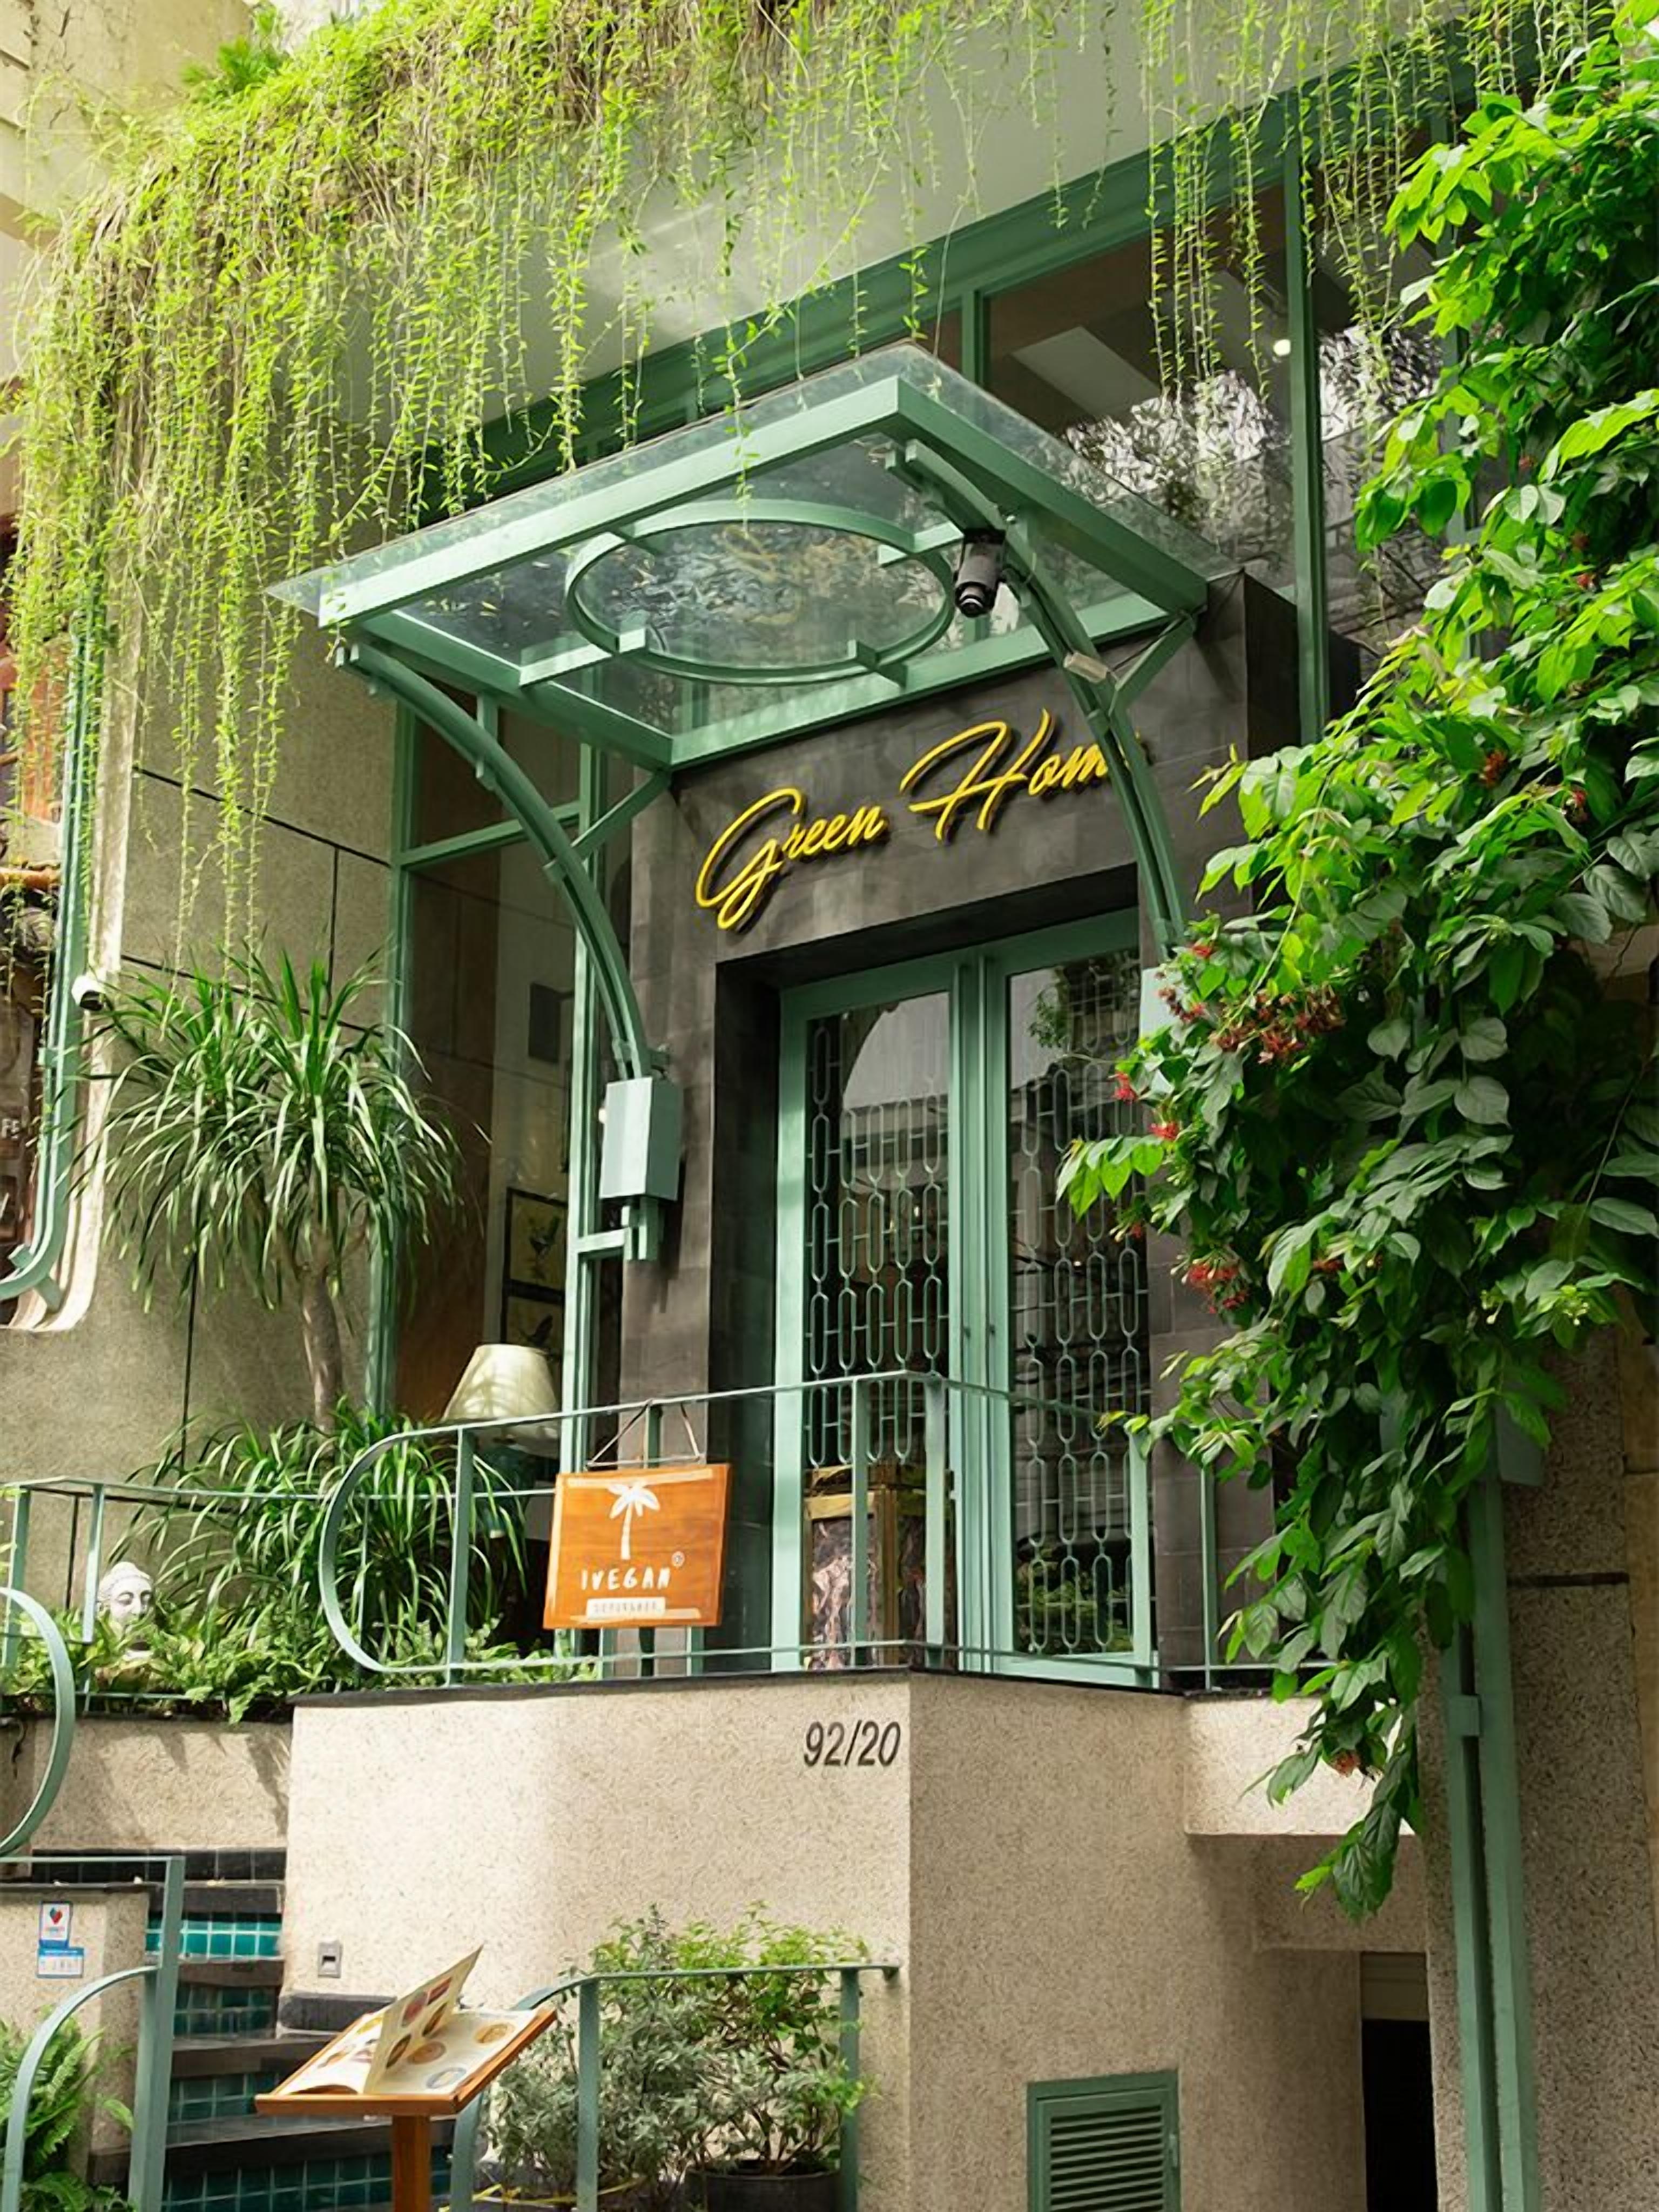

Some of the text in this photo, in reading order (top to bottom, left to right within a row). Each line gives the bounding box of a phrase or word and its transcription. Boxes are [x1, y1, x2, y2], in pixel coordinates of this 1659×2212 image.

[696, 708, 1141, 930] Green Hom
[804, 1719, 901, 1766] 92/20
